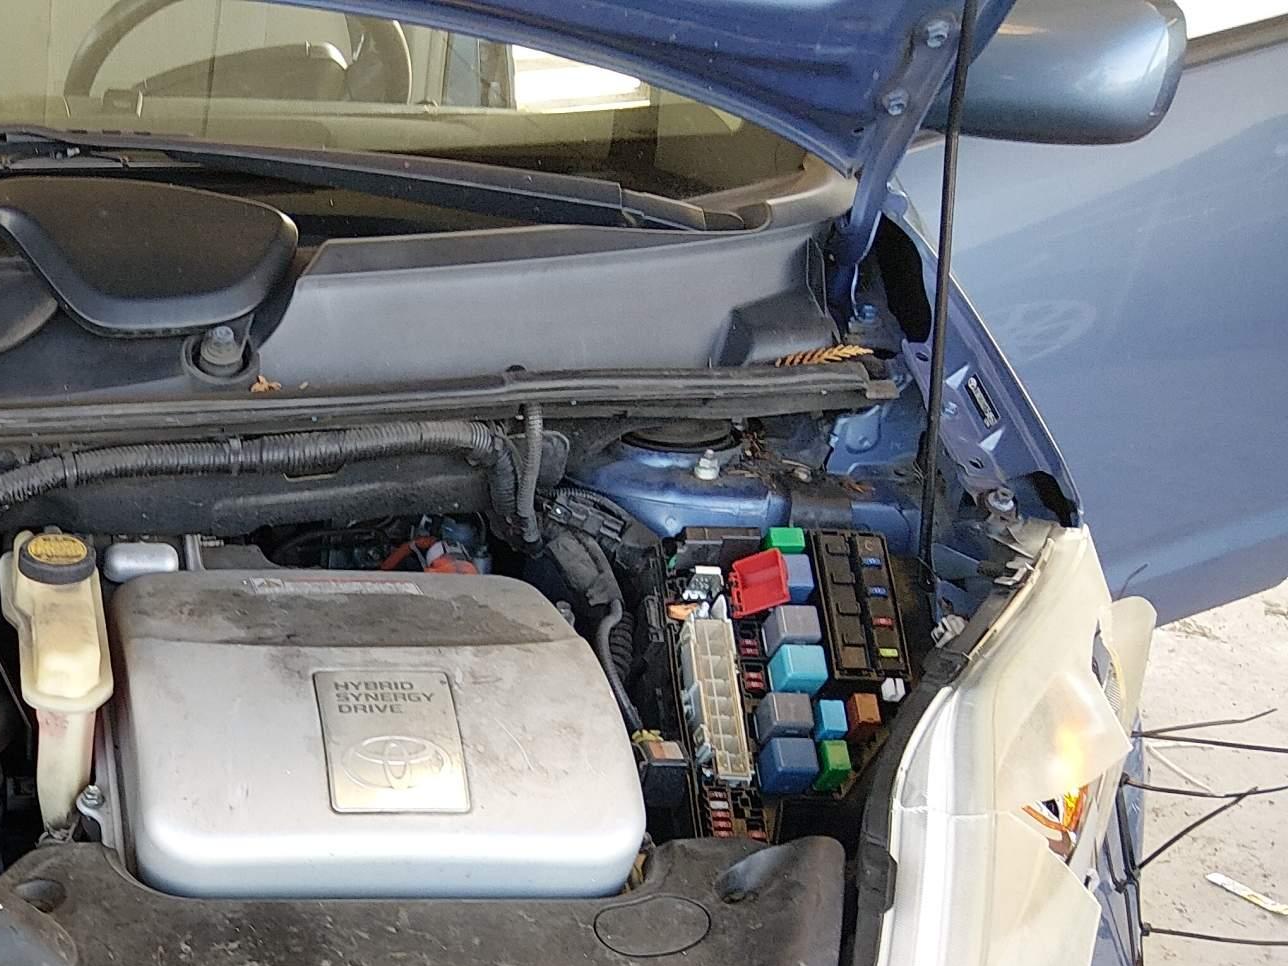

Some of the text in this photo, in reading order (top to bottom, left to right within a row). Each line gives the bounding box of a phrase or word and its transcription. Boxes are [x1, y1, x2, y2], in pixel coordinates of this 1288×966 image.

[333, 681, 414, 691] HYBRID
[335, 692, 435, 703] SYNERGY
[337, 703, 404, 714] DRIVE
